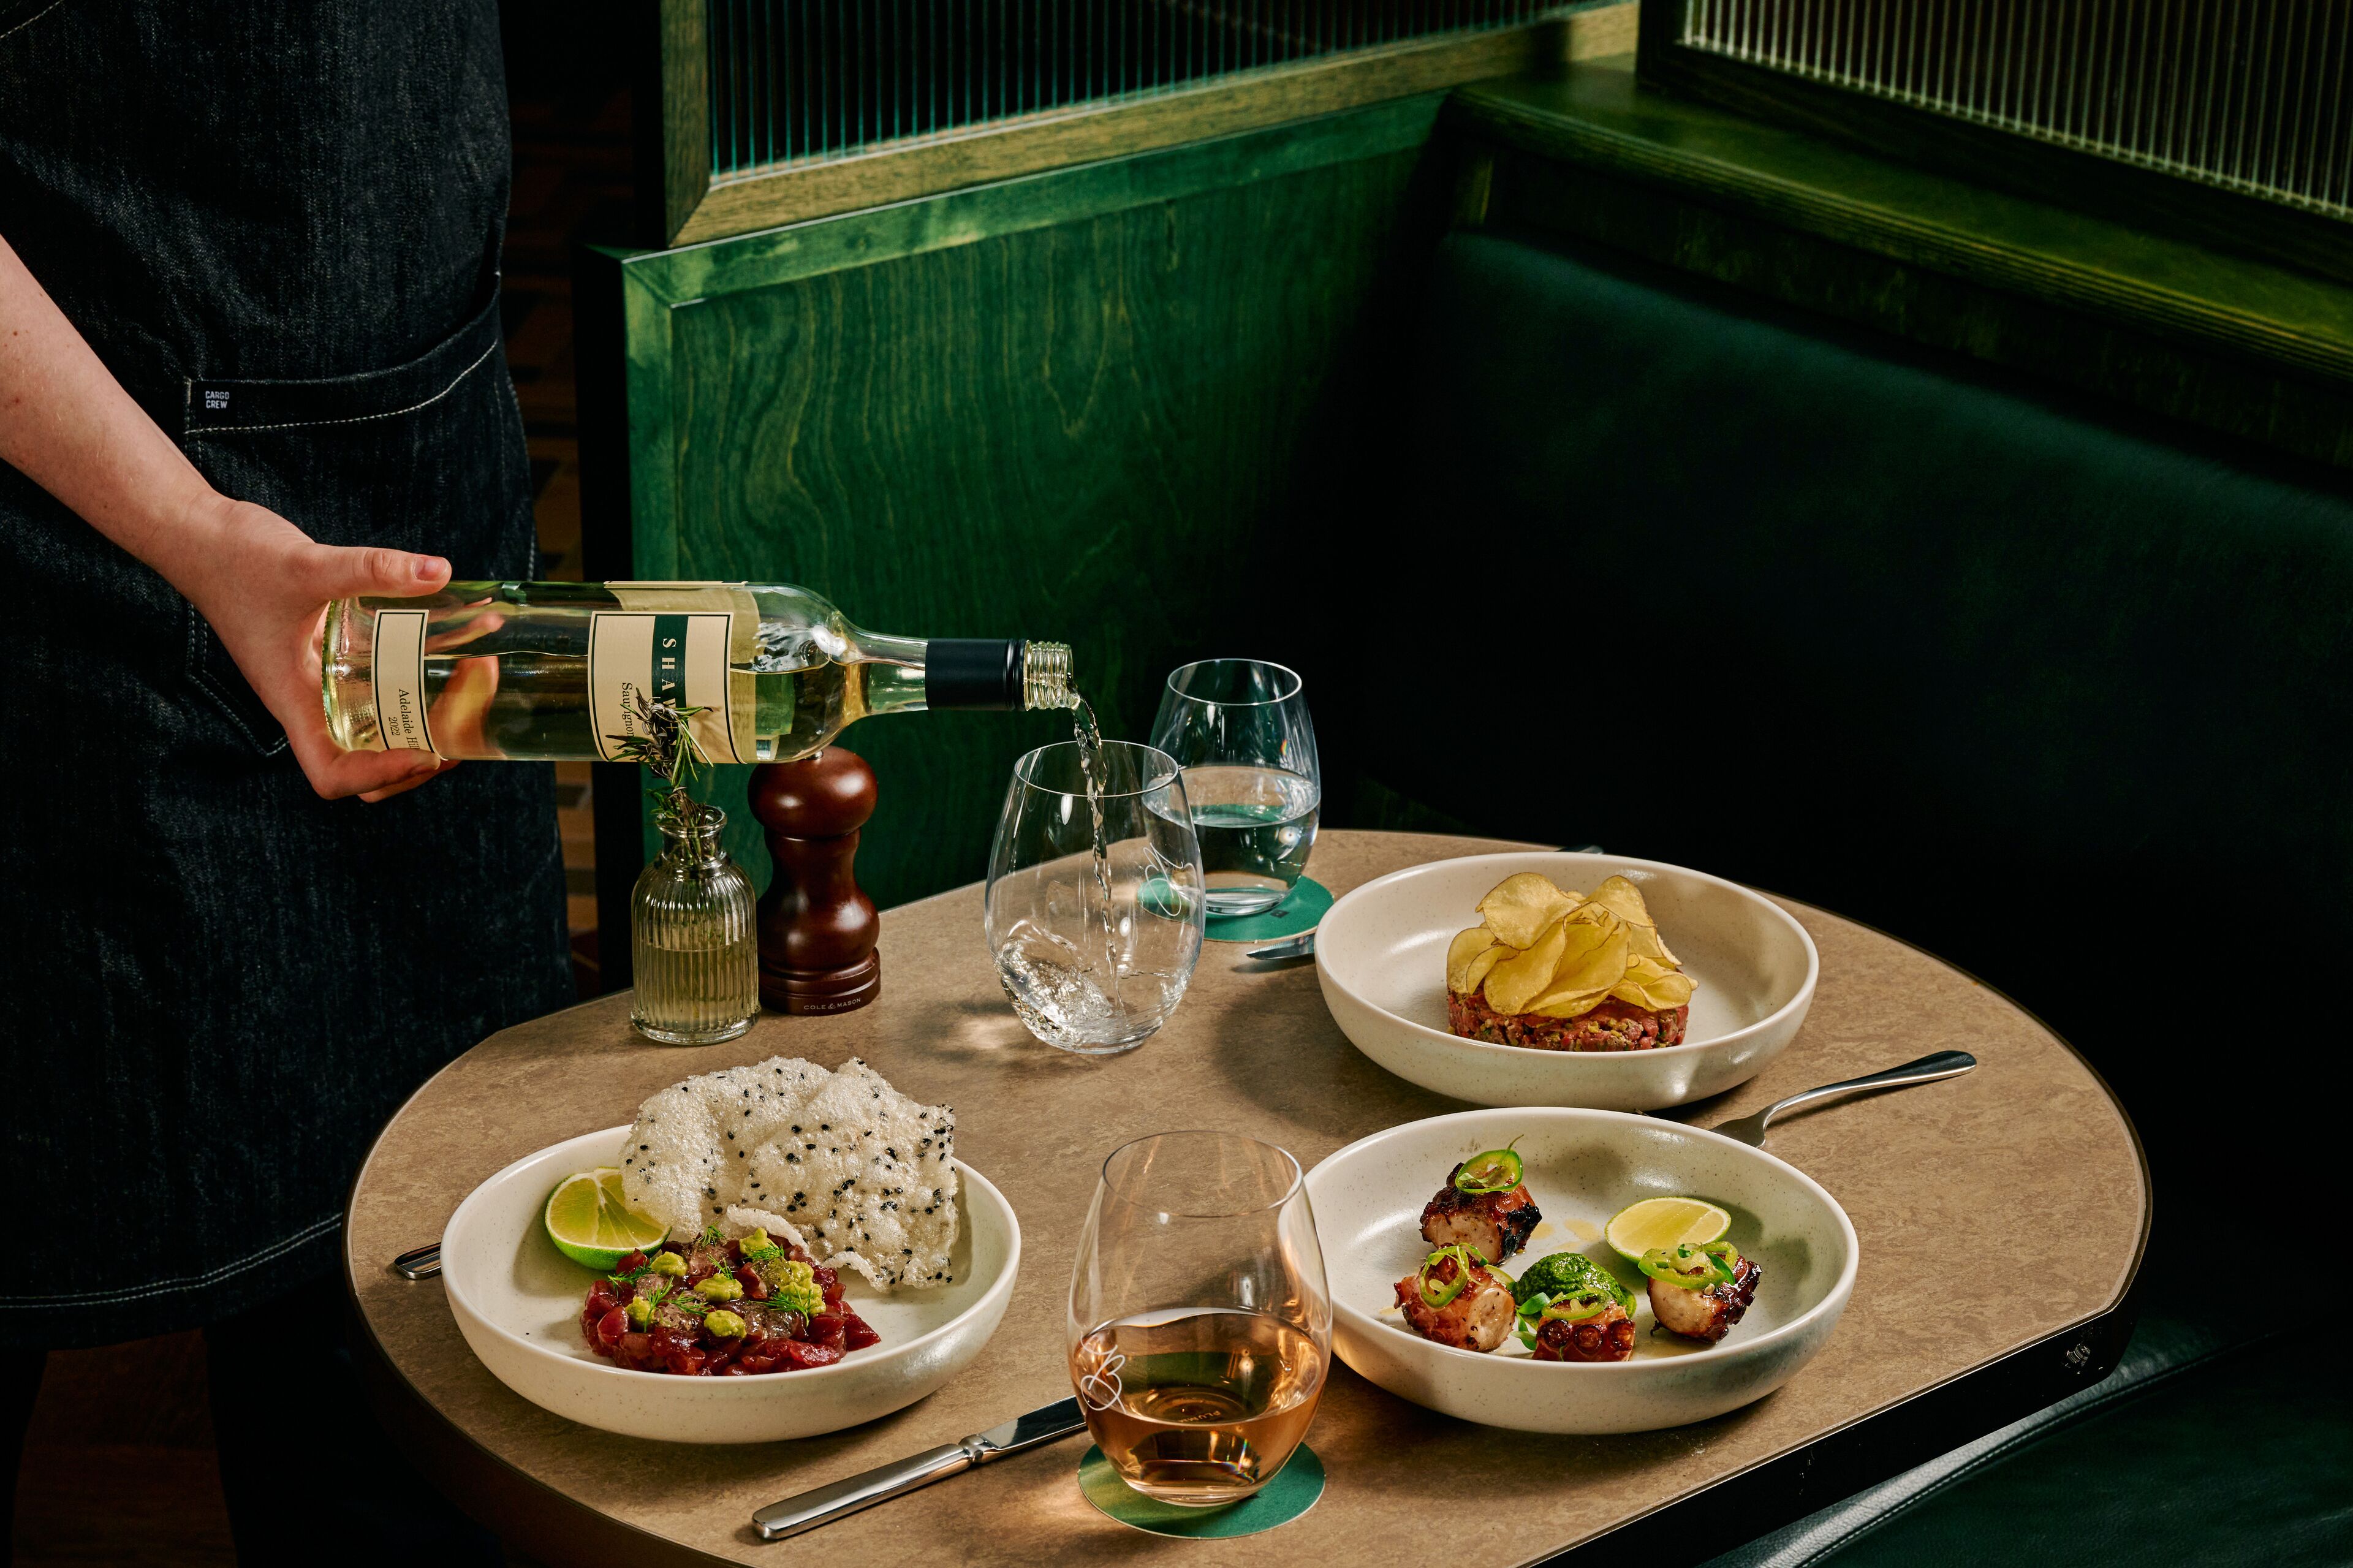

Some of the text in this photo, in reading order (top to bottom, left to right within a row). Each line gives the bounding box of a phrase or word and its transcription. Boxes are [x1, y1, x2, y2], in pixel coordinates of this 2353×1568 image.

[205, 391, 230, 400] CARGO
[206, 400, 228, 409] CREW
[399, 688, 414, 734] Adelaide
[388, 716, 401, 736] 2022
[837, 998, 861, 1008] MASON
